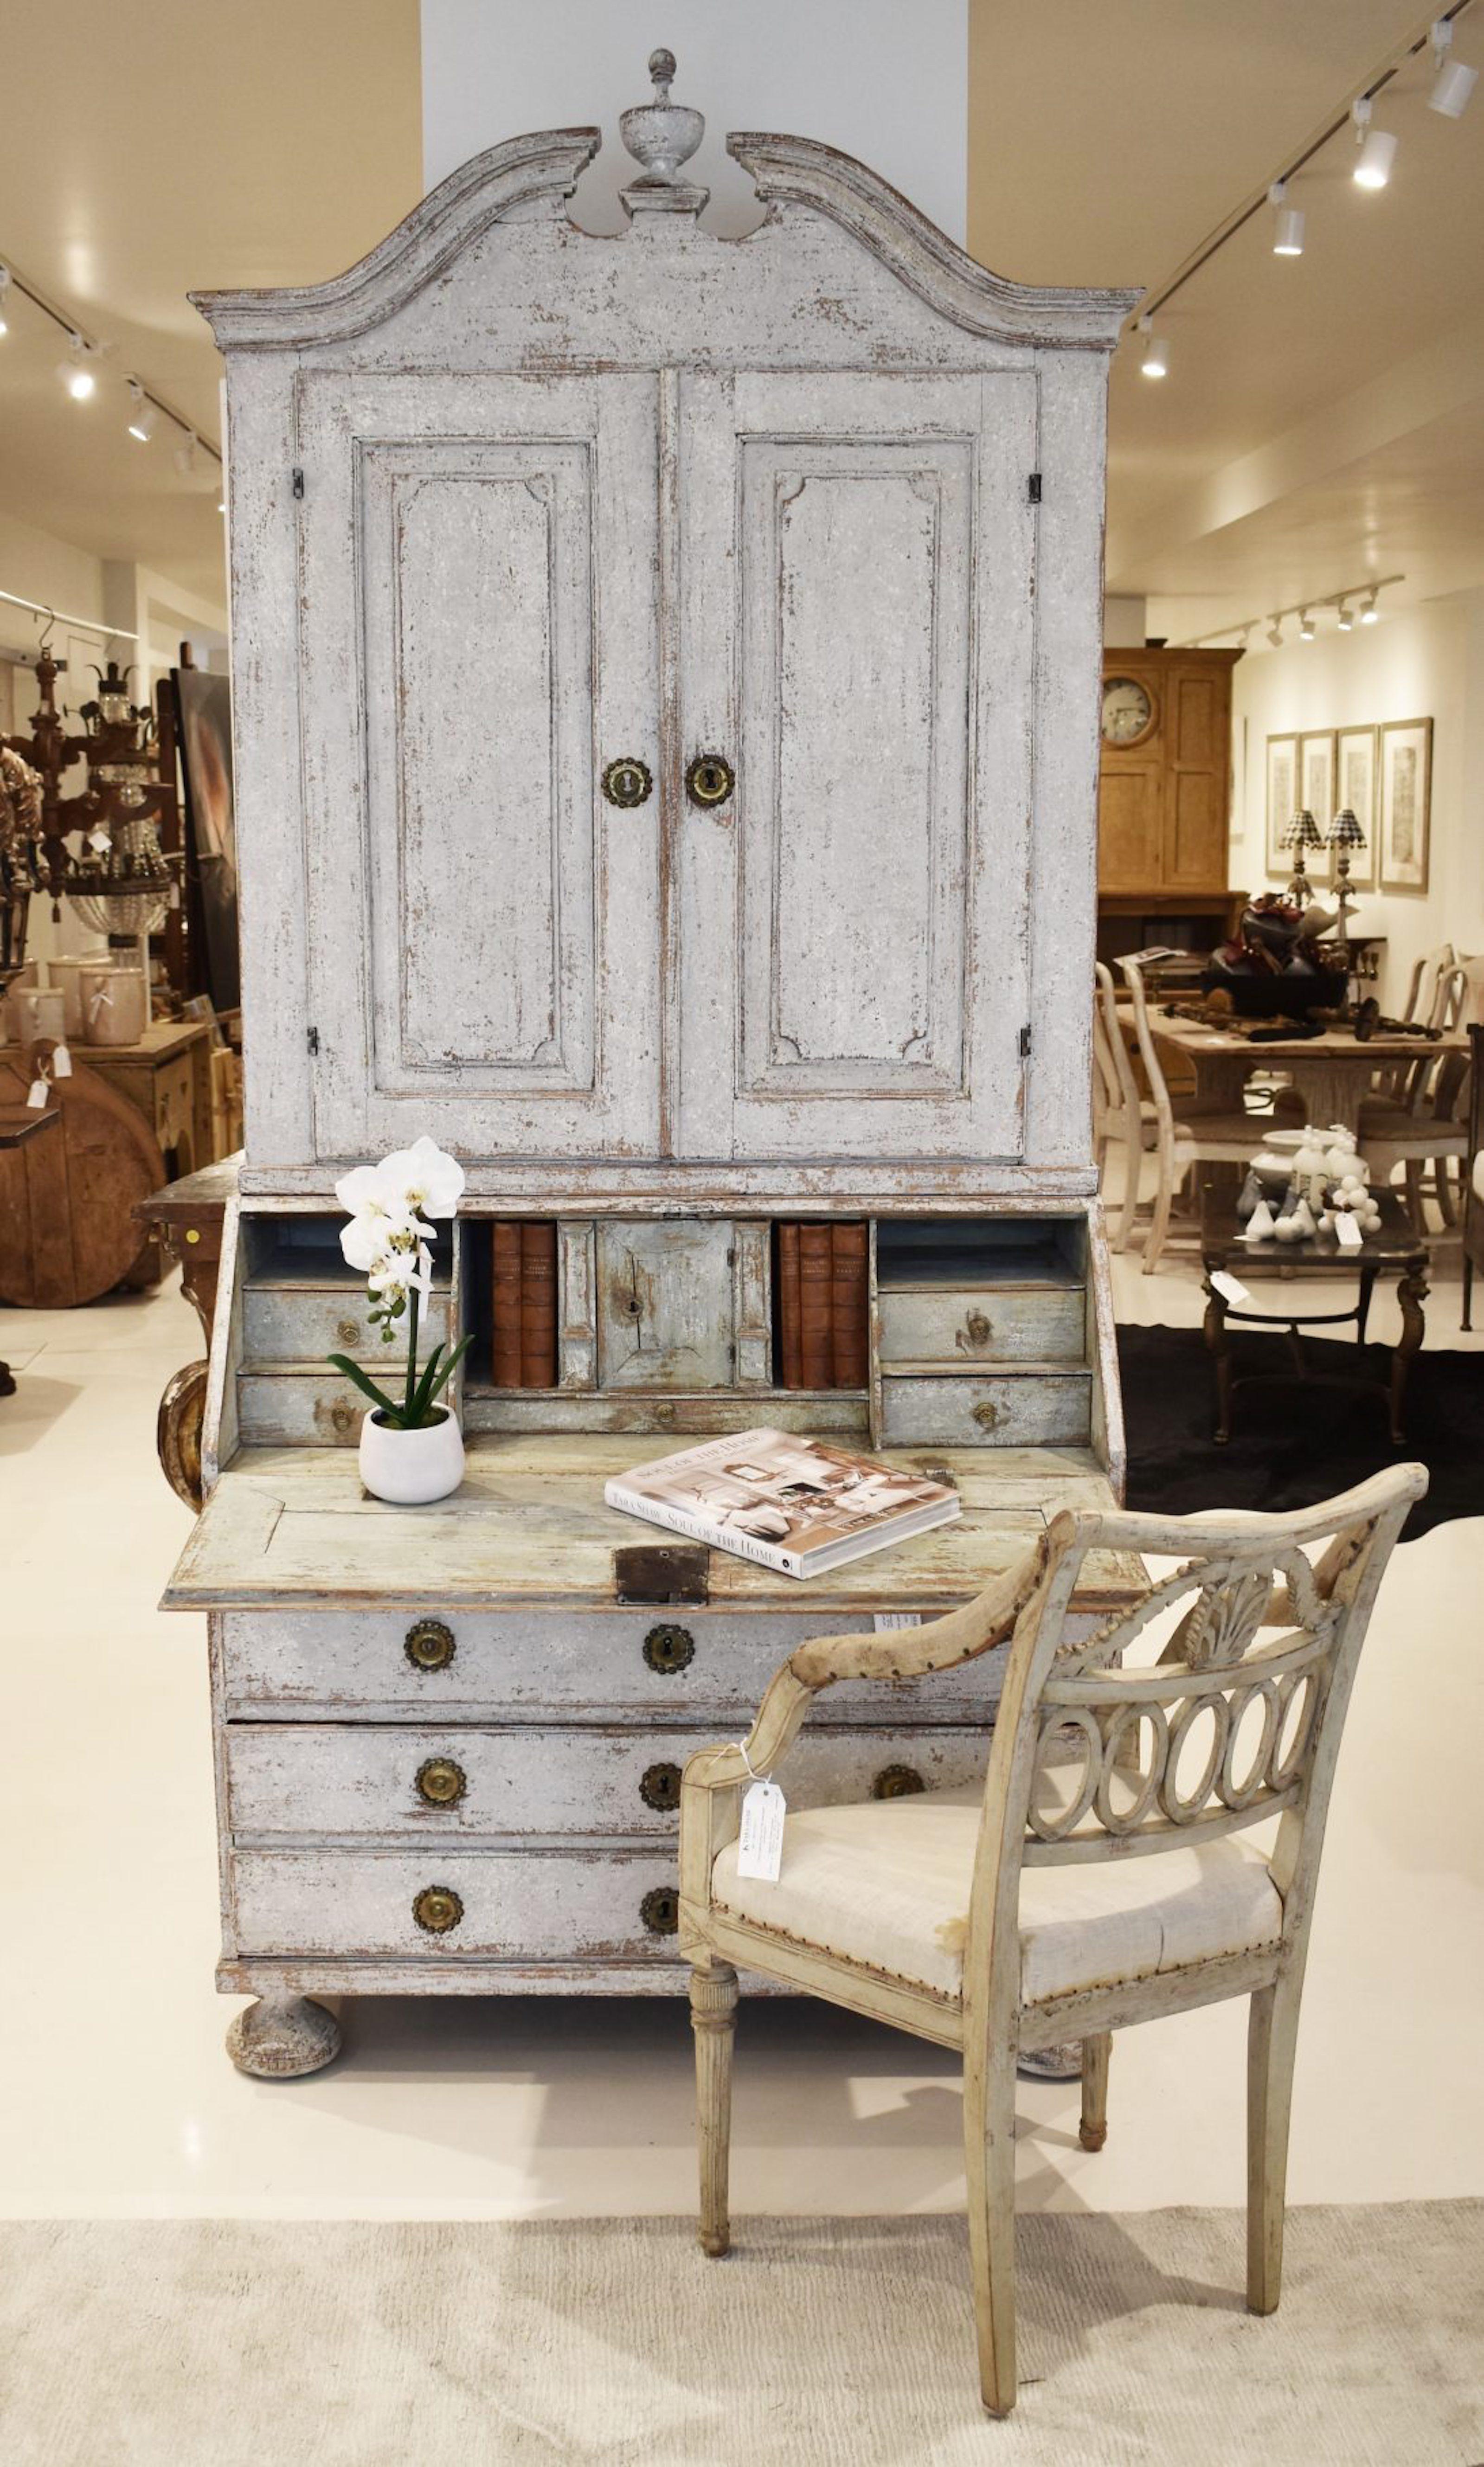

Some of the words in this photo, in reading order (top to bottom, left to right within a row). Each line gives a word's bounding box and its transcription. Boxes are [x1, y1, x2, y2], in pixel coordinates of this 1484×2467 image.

[613, 1492, 636, 1510] TARA
[636, 1501, 660, 1519] SHAW
[668, 1512, 695, 1532] SOUL
[698, 1526, 713, 1540] OF
[717, 1533, 739, 1550] THE
[740, 1539, 777, 1564] HOME
